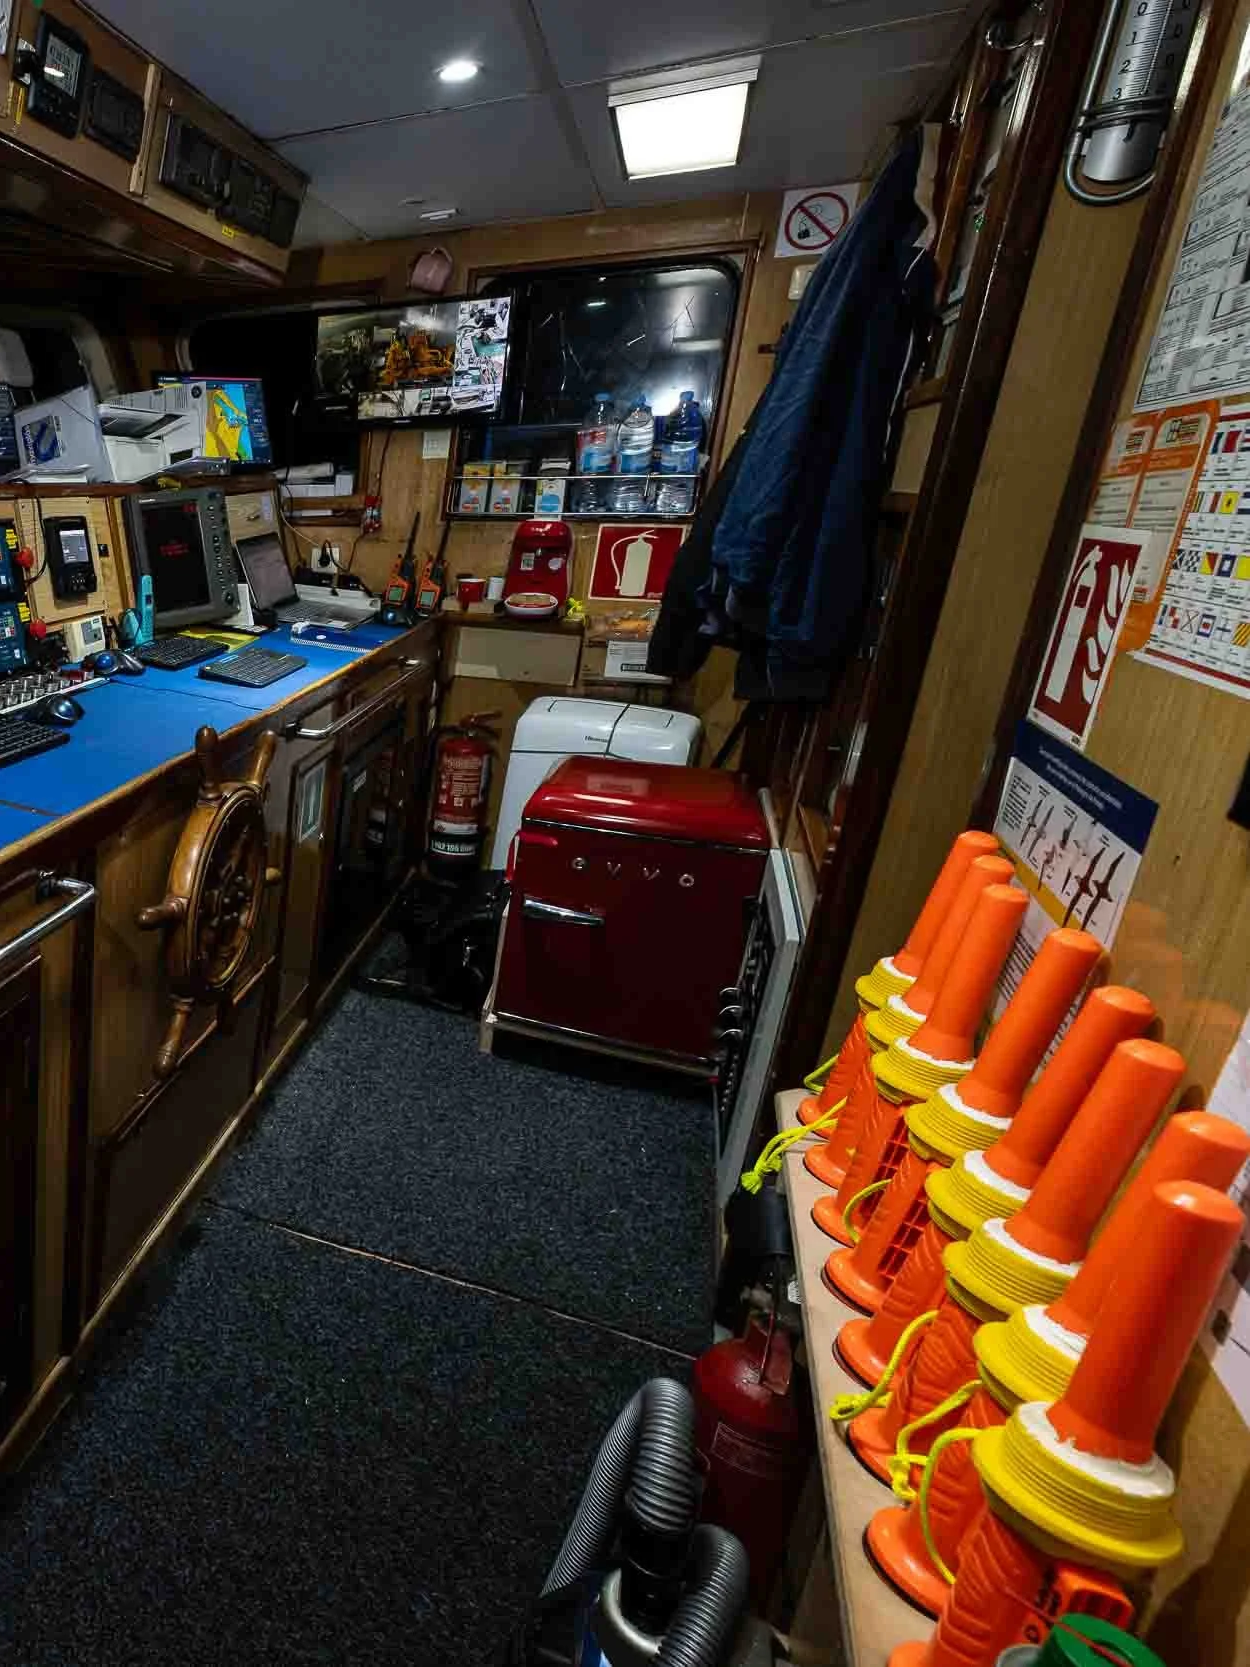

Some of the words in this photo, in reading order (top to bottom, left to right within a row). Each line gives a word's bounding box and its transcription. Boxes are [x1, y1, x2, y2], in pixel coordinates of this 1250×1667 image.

[1137, 2, 1148, 16] 0
[1132, 31, 1138, 43] 1
[1120, 60, 1130, 73] 2
